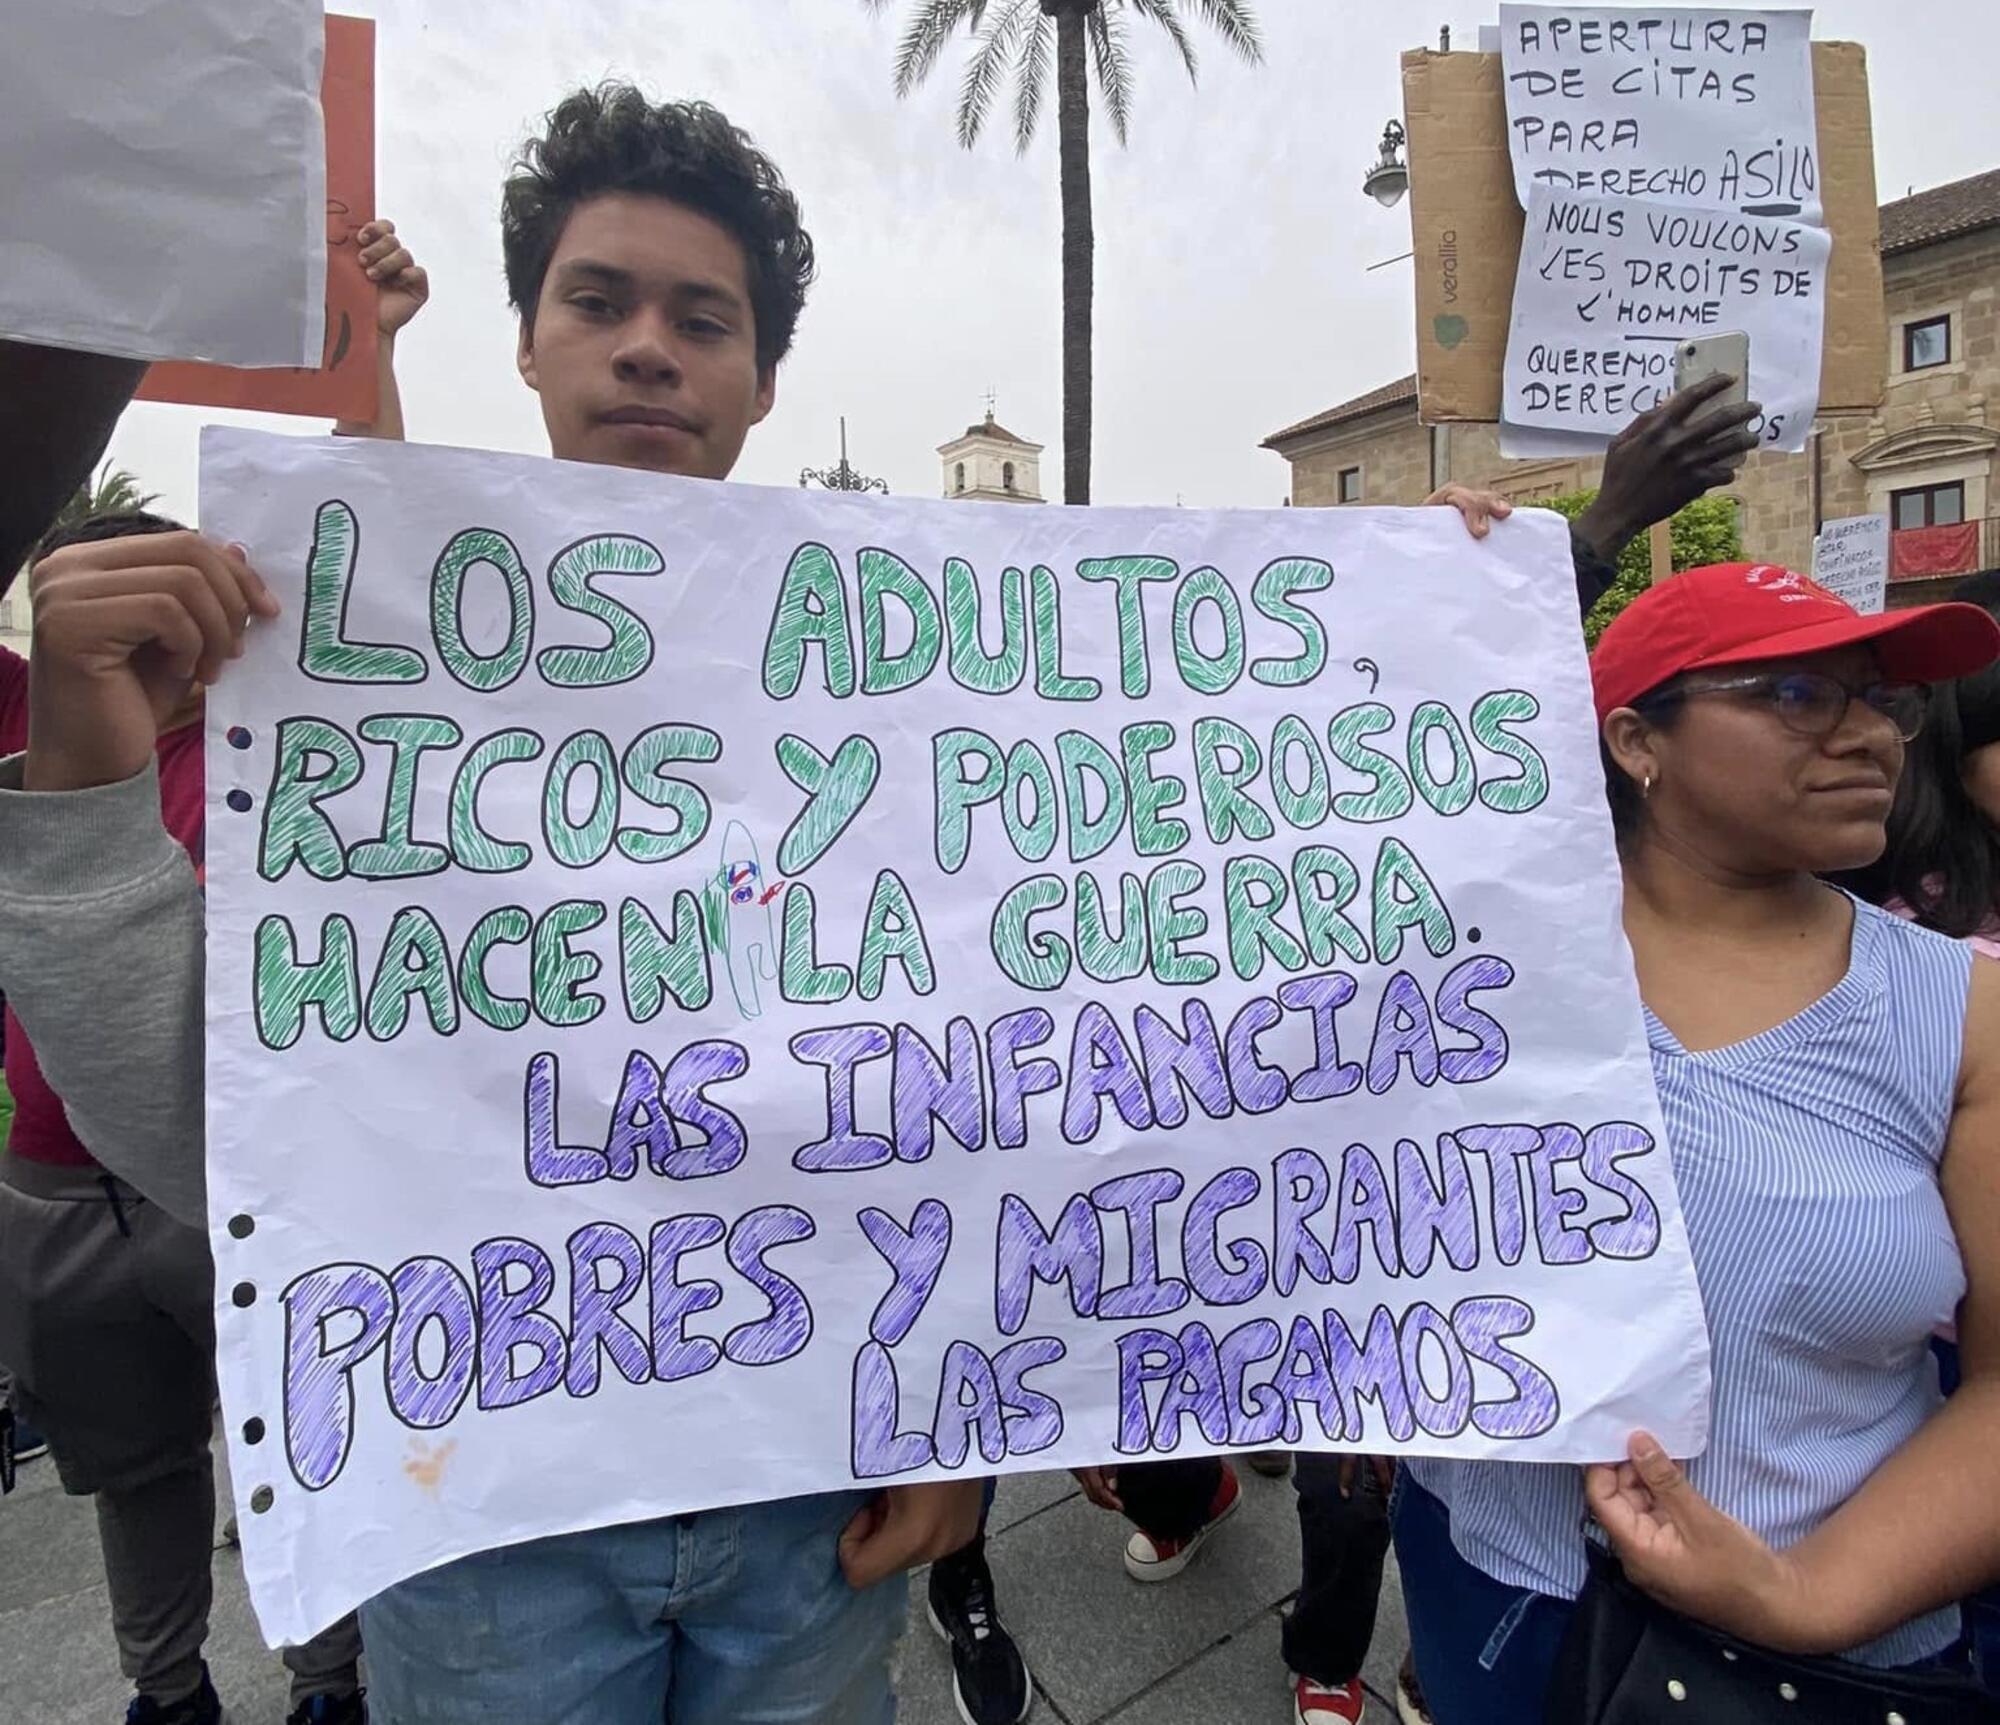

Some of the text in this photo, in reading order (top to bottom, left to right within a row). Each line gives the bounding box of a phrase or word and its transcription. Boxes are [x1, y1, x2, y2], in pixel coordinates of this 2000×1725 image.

[1520, 18, 1767, 55] APERTURA
[1510, 68, 1585, 98] DE
[1513, 116, 1640, 153] PARA
[1534, 165, 1706, 196] DERECHO
[1545, 201, 1802, 255] NOUS VOULONS
[1439, 229, 1457, 304] verallia
[1540, 245, 1606, 281] LES
[1774, 270, 1812, 298] DE
[1521, 382, 1673, 415] DERECH
[297, 499, 1381, 700] LOS ADULTOS,
[257, 689, 1550, 882] RICOS Y PODEROSOS
[253, 836, 1482, 1051] HACEN LA GUERRA.
[525, 956, 1516, 1188] LAS INFANCIAS
[278, 1120, 1662, 1492] POBRES Y MIGRANTES
[852, 1294, 1561, 1479] LAS PAGAMOS
